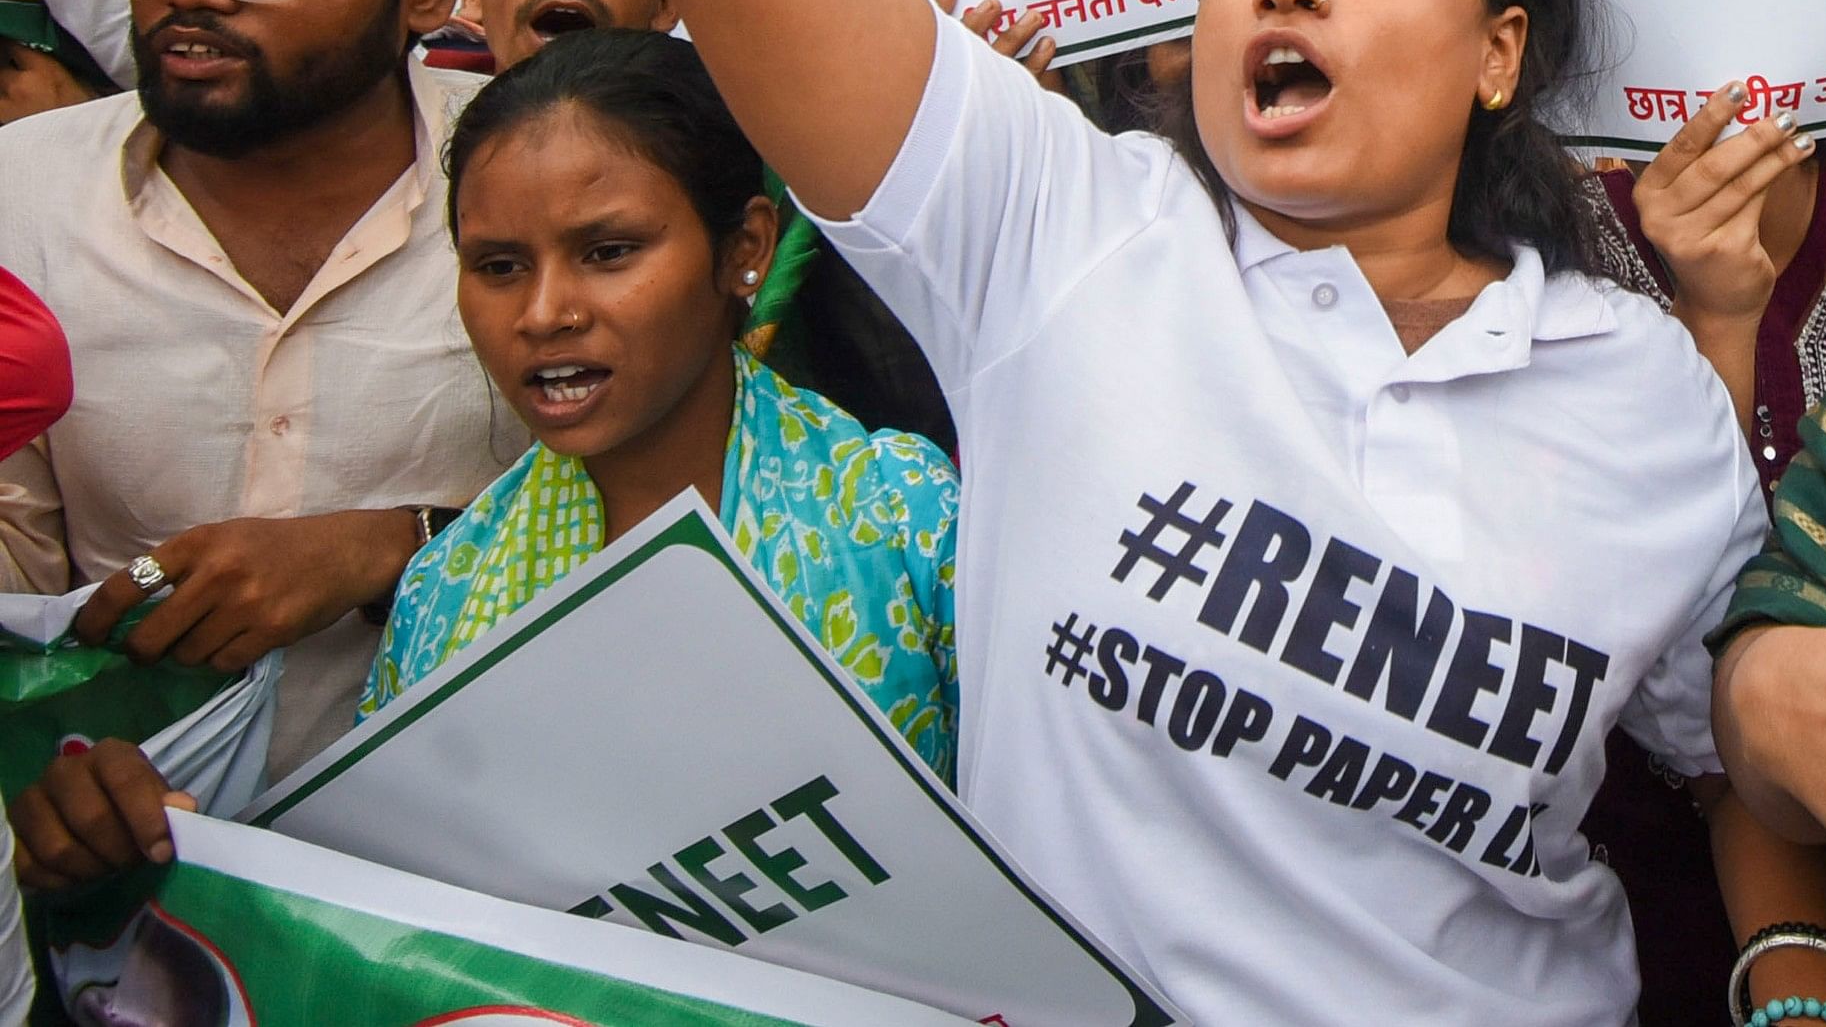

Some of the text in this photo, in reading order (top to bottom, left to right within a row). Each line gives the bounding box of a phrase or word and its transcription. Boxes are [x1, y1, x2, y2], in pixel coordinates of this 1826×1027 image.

[1623, 85, 1688, 124] छात्र
[1110, 481, 1610, 776] #RENEET
[1044, 611, 1274, 758] #STOP
[1267, 714, 1492, 854] PAPER
[566, 775, 892, 947] NEET
